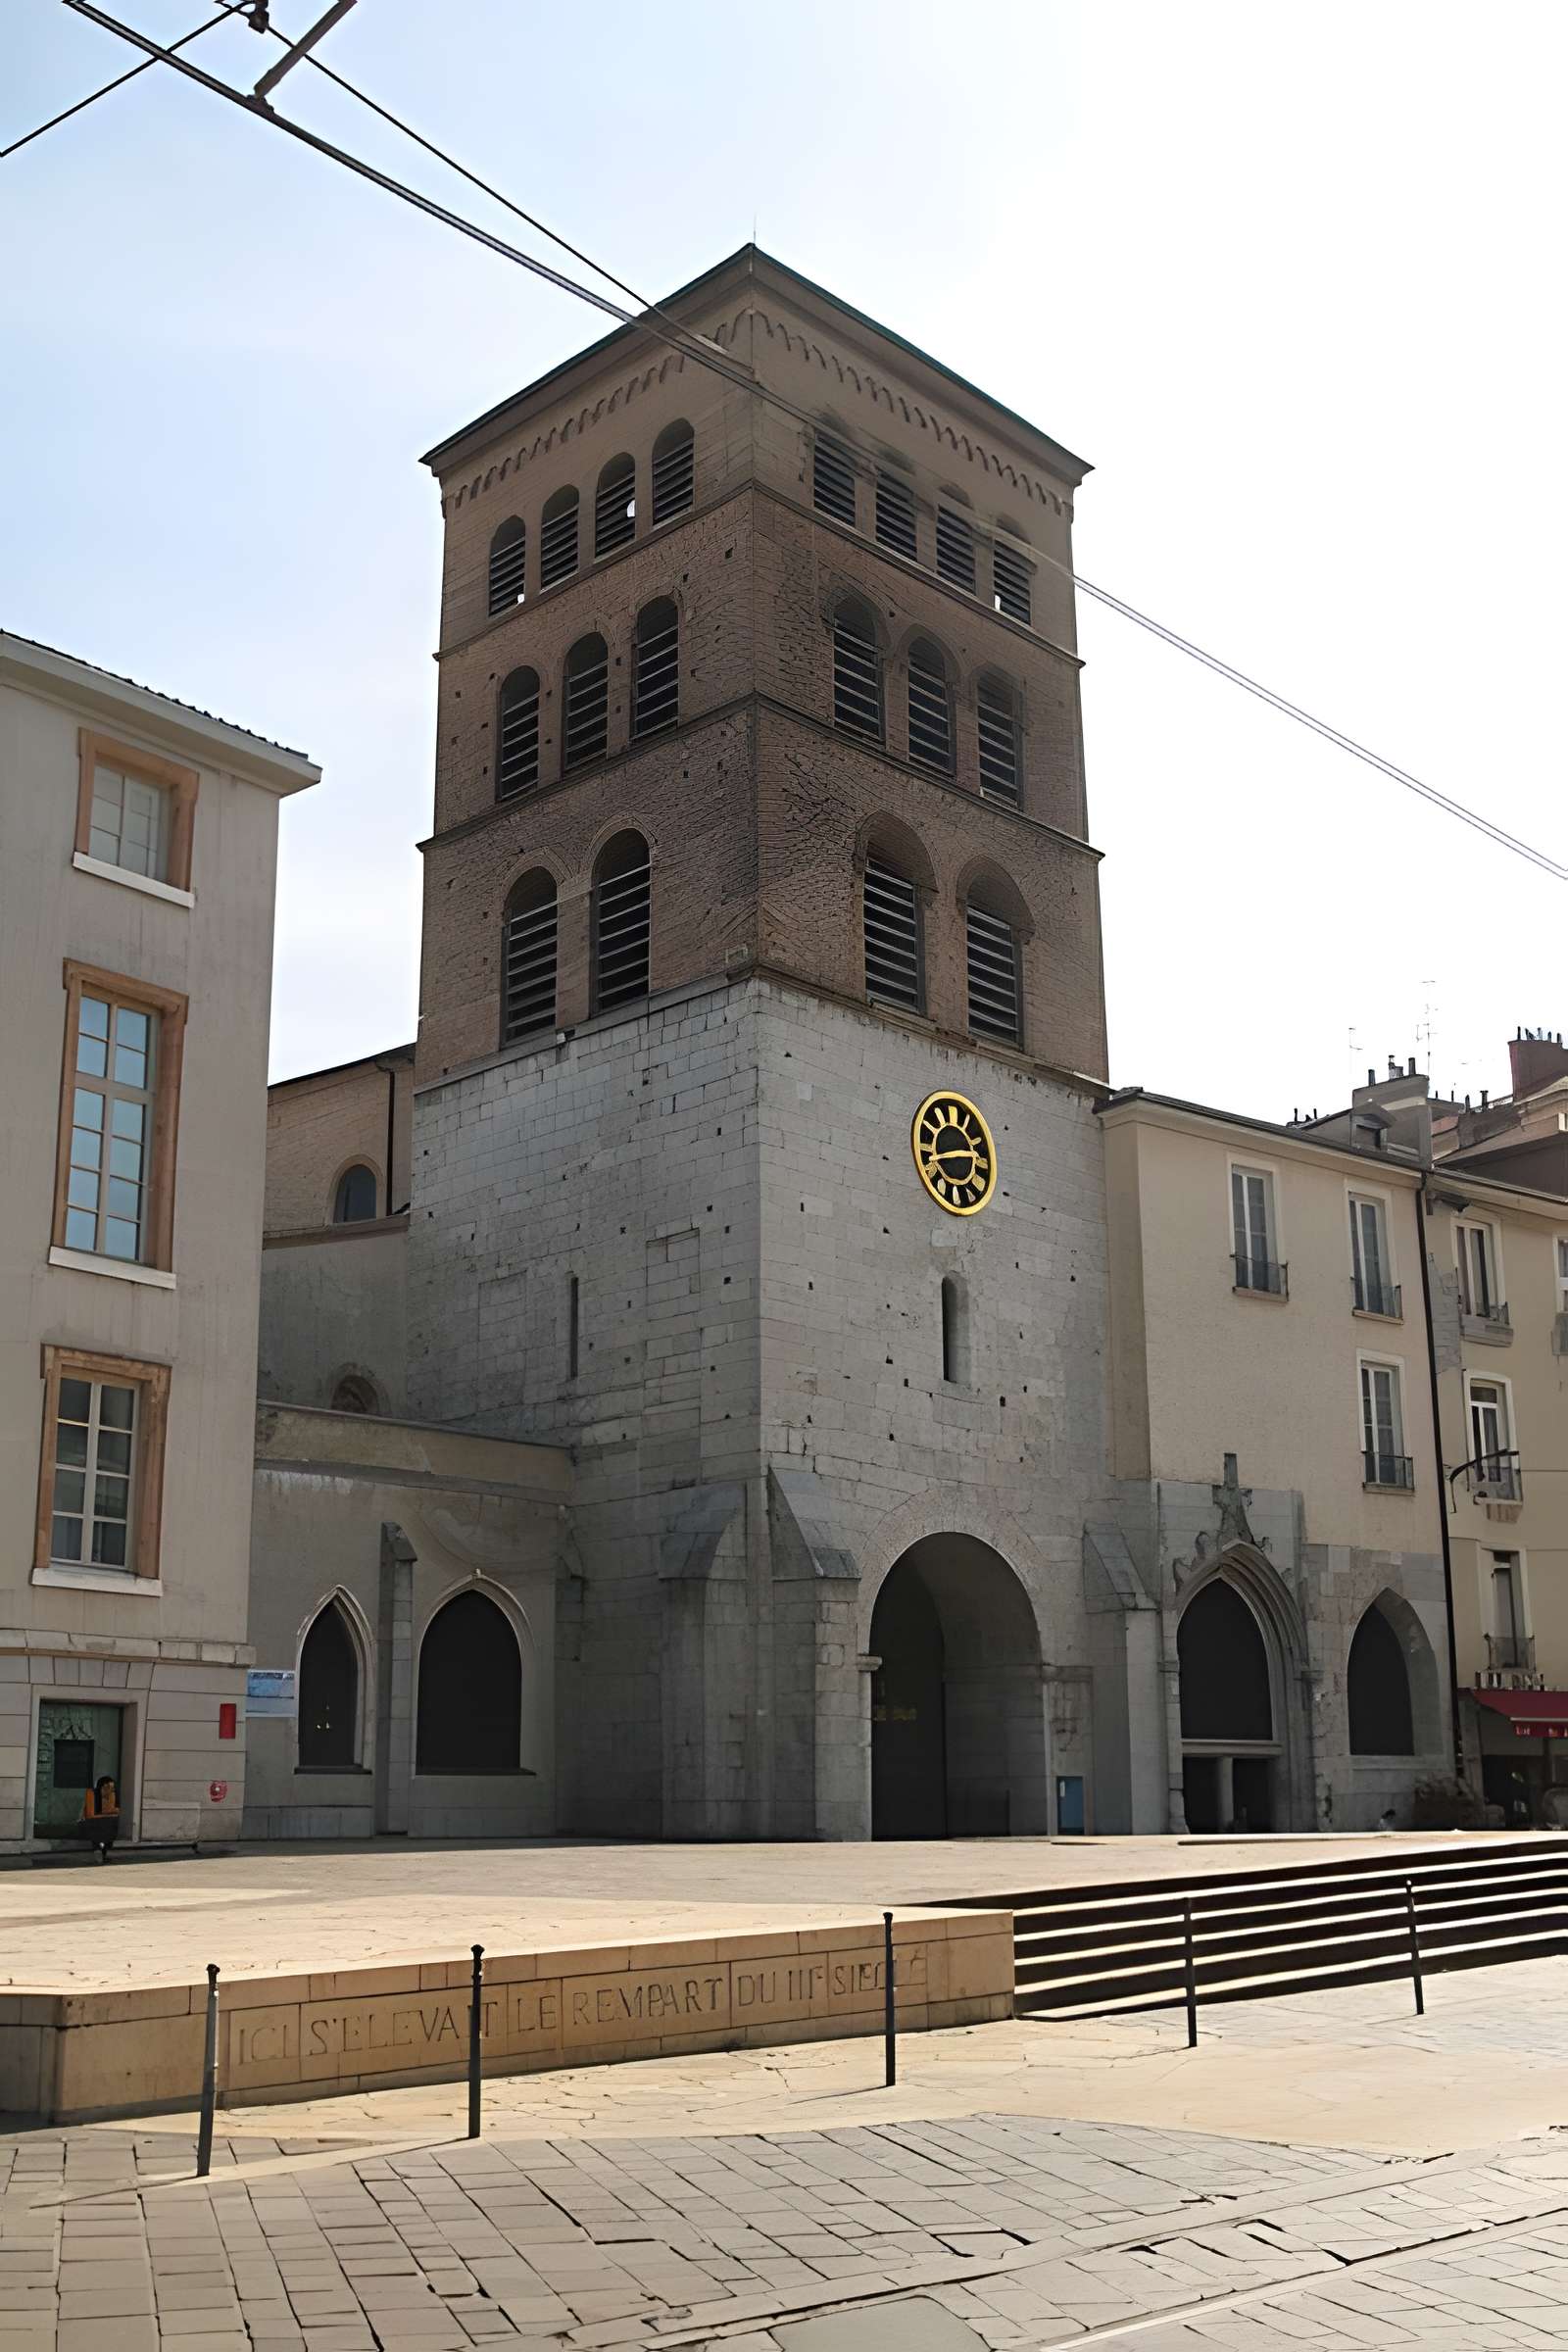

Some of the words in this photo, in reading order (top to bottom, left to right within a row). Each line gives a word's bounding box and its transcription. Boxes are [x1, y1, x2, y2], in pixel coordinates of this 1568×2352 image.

[238, 2024, 288, 2065] ICI
[308, 2000, 498, 2056] S'ELEVAT
[516, 1995, 558, 2034] LE
[572, 1977, 723, 2026] REMPART
[737, 1971, 776, 2007] DU
